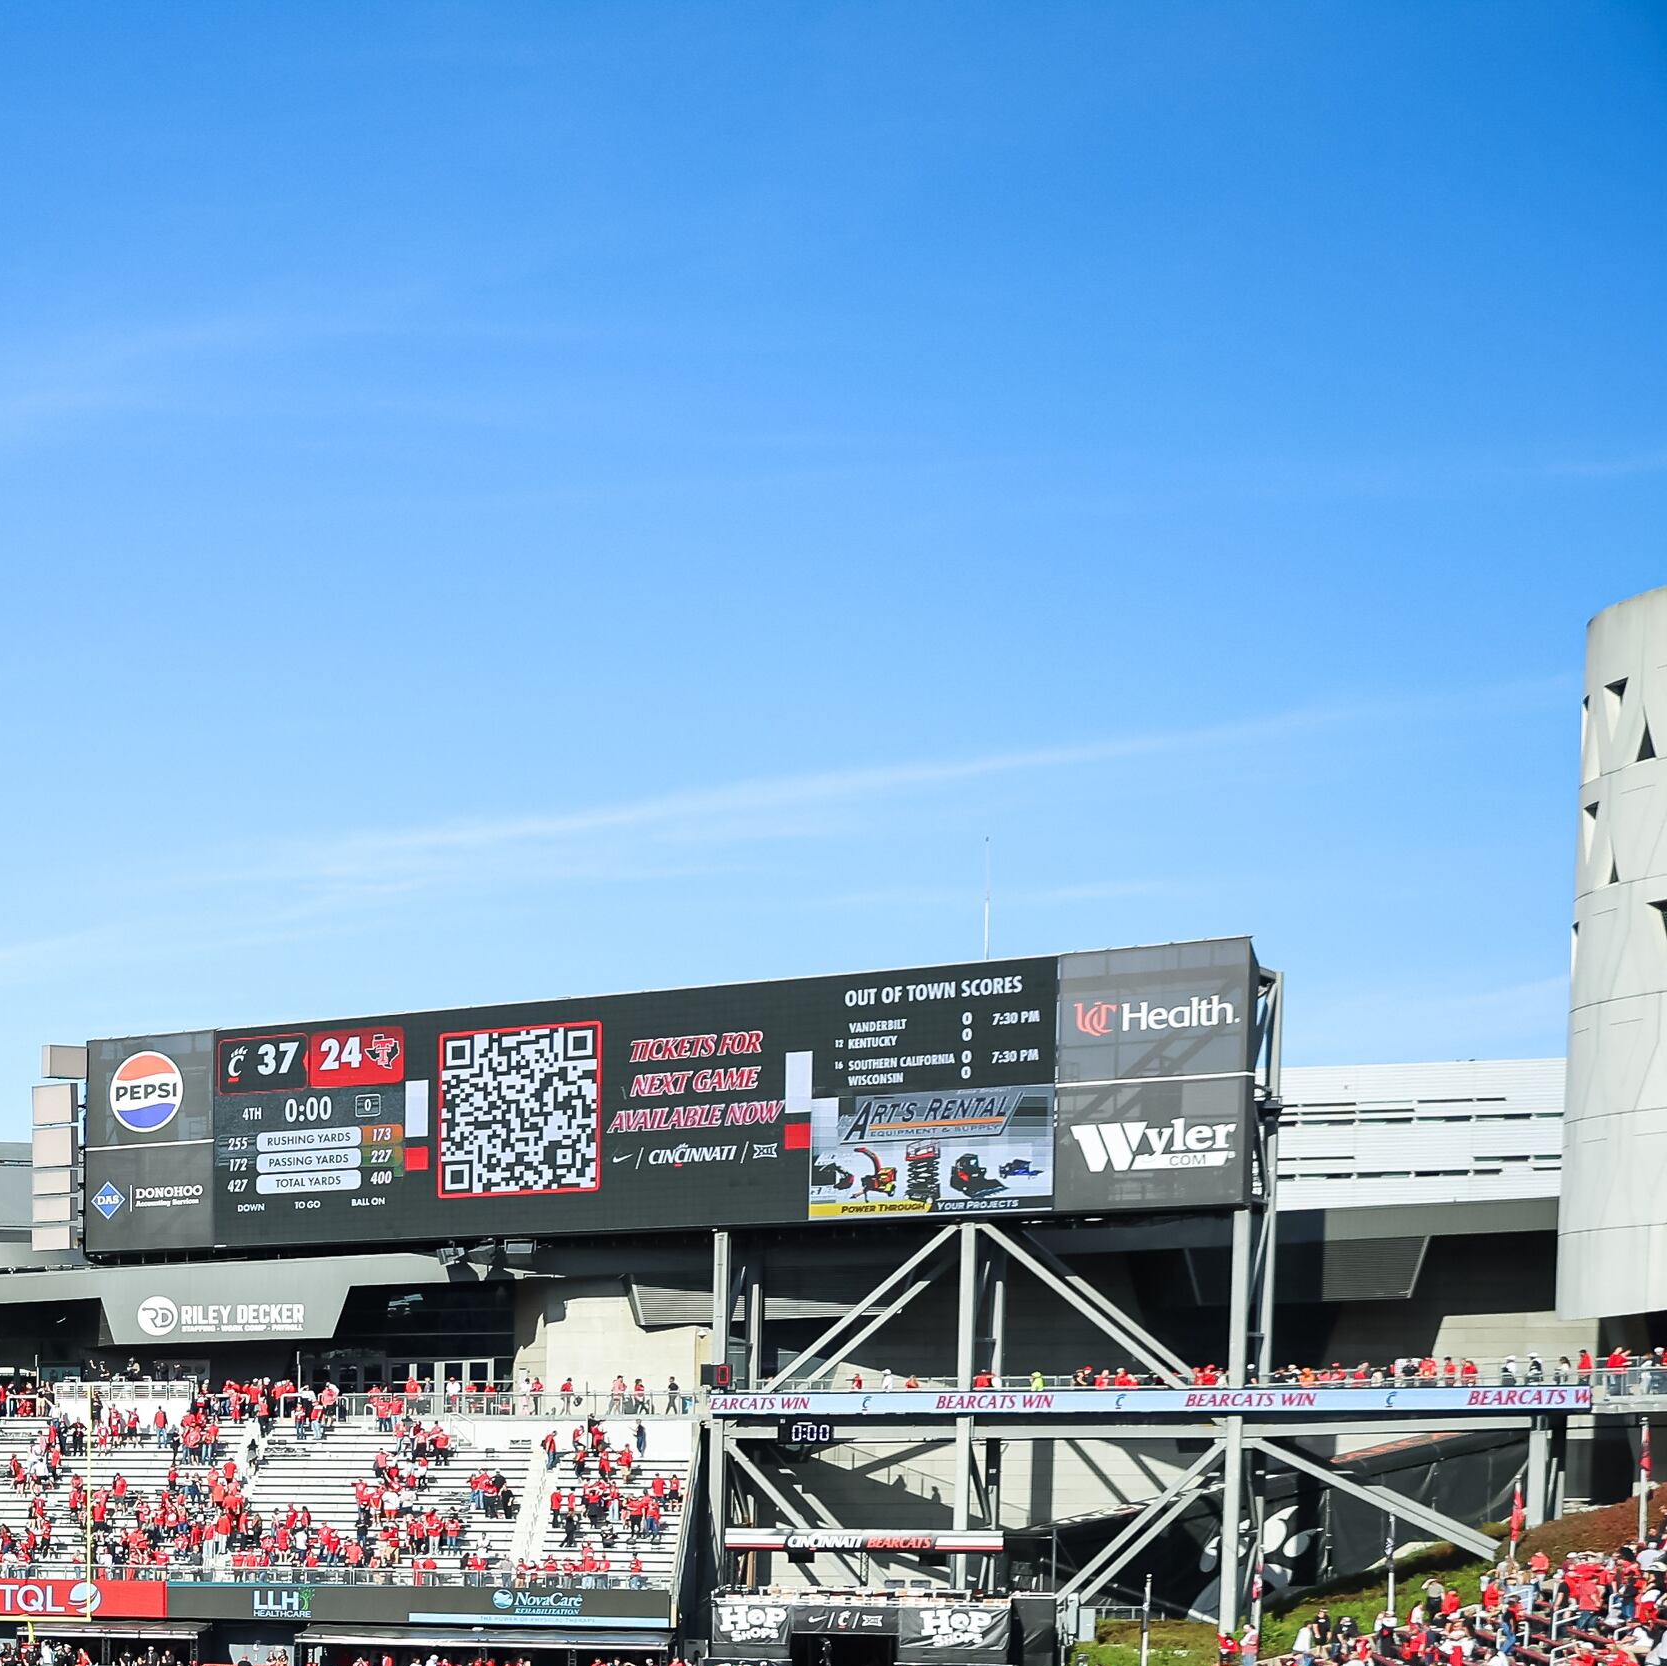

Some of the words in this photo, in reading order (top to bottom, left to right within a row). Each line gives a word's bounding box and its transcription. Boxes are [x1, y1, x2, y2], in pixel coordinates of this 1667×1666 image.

[844, 988, 877, 1007] OUT
[881, 985, 903, 1004] OF
[906, 981, 956, 1002] TOWN
[961, 975, 1023, 998] SCORES
[848, 1018, 908, 1034] VANDERBILT
[962, 1011, 973, 1026] 0
[991, 1011, 1018, 1026] 7:30
[1020, 1009, 1041, 1024] PM
[629, 1033, 717, 1063] TICKETS
[718, 1030, 764, 1056] FOR
[835, 1039, 844, 1048] 12
[848, 1035, 898, 1050] KENTUCKY
[962, 1028, 973, 1042] 0
[257, 1041, 300, 1076] 37
[319, 1036, 363, 1071] 24
[835, 1060, 844, 1070] 16
[848, 1055, 898, 1072] SOUTHERN
[900, 1052, 956, 1068] CALIFORNIA
[961, 1050, 972, 1064] 0
[991, 1050, 1018, 1064] 7:30
[1019, 1047, 1040, 1062] PM
[630, 1070, 693, 1098] NEXT
[692, 1065, 762, 1094] GAME
[847, 1072, 904, 1087] WISCONSIN
[961, 1066, 972, 1080] 0
[115, 1081, 178, 1102] PEPSI
[242, 1107, 262, 1121] 4TH
[284, 1095, 332, 1123] 0:00
[364, 1098, 372, 1112] 0
[607, 1103, 725, 1134] AVAILABLE
[724, 1098, 786, 1126] NOW
[843, 1098, 918, 1141] ART'S
[923, 1094, 1007, 1122] RENTAL
[227, 1137, 248, 1151] 255
[266, 1133, 315, 1147] RUSHING
[318, 1131, 351, 1144] YARDS
[371, 1127, 391, 1142] 173
[870, 1127, 937, 1138] EQUIPMENT
[954, 1124, 1001, 1133] SUPPLY
[648, 1142, 738, 1167] CINCINNATI
[1069, 1117, 1238, 1173] Wyler
[228, 1158, 248, 1172] 172
[268, 1155, 313, 1168] PASSING
[316, 1153, 349, 1165] YARDS
[370, 1149, 393, 1163] 227
[135, 1184, 203, 1199] DONOHOO
[227, 1178, 249, 1193] 427
[275, 1177, 305, 1189] TOTAL
[308, 1175, 342, 1187] YARDS
[370, 1170, 393, 1185] 400
[97, 1194, 119, 1206] DAS
[237, 1203, 265, 1213] DOWN
[294, 1200, 306, 1210] TO
[306, 1199, 321, 1209] GO
[351, 1197, 370, 1207] BALL
[370, 1196, 386, 1206] ON
[841, 1203, 878, 1214] POWER
[879, 1202, 926, 1213] THROUGH
[937, 1200, 965, 1211] YOUR
[966, 1198, 1020, 1209] PROJECTS
[180, 1303, 232, 1325] RILEY
[236, 1302, 305, 1324] DECKER
[181, 1324, 216, 1333] STAFFING
[221, 1324, 244, 1333] WORK
[244, 1324, 267, 1332] COMP
[271, 1323, 304, 1332] PAYROLL
[709, 1396, 775, 1410] EARCATS
[780, 1396, 810, 1410] WIN
[935, 1394, 1017, 1409] BEARCATS
[1022, 1394, 1054, 1409] WIN
[1184, 1393, 1274, 1407] BEARCATS
[1280, 1393, 1317, 1406] WIN
[1467, 1390, 1566, 1406] BEARCATS
[791, 1424, 831, 1443] 0:00
[787, 1533, 864, 1550] CINCINNATI
[866, 1536, 933, 1549] BEARCATS
[253, 1589, 300, 1610] LLH
[513, 1590, 584, 1607] NovaCare
[253, 1609, 312, 1618] HEALTHCARE
[514, 1607, 581, 1616] REHABILITATION
[718, 1605, 787, 1633] HOP
[919, 1607, 993, 1636] HOP
[730, 1627, 779, 1642] SHOPS
[932, 1632, 984, 1648] SHOPS
